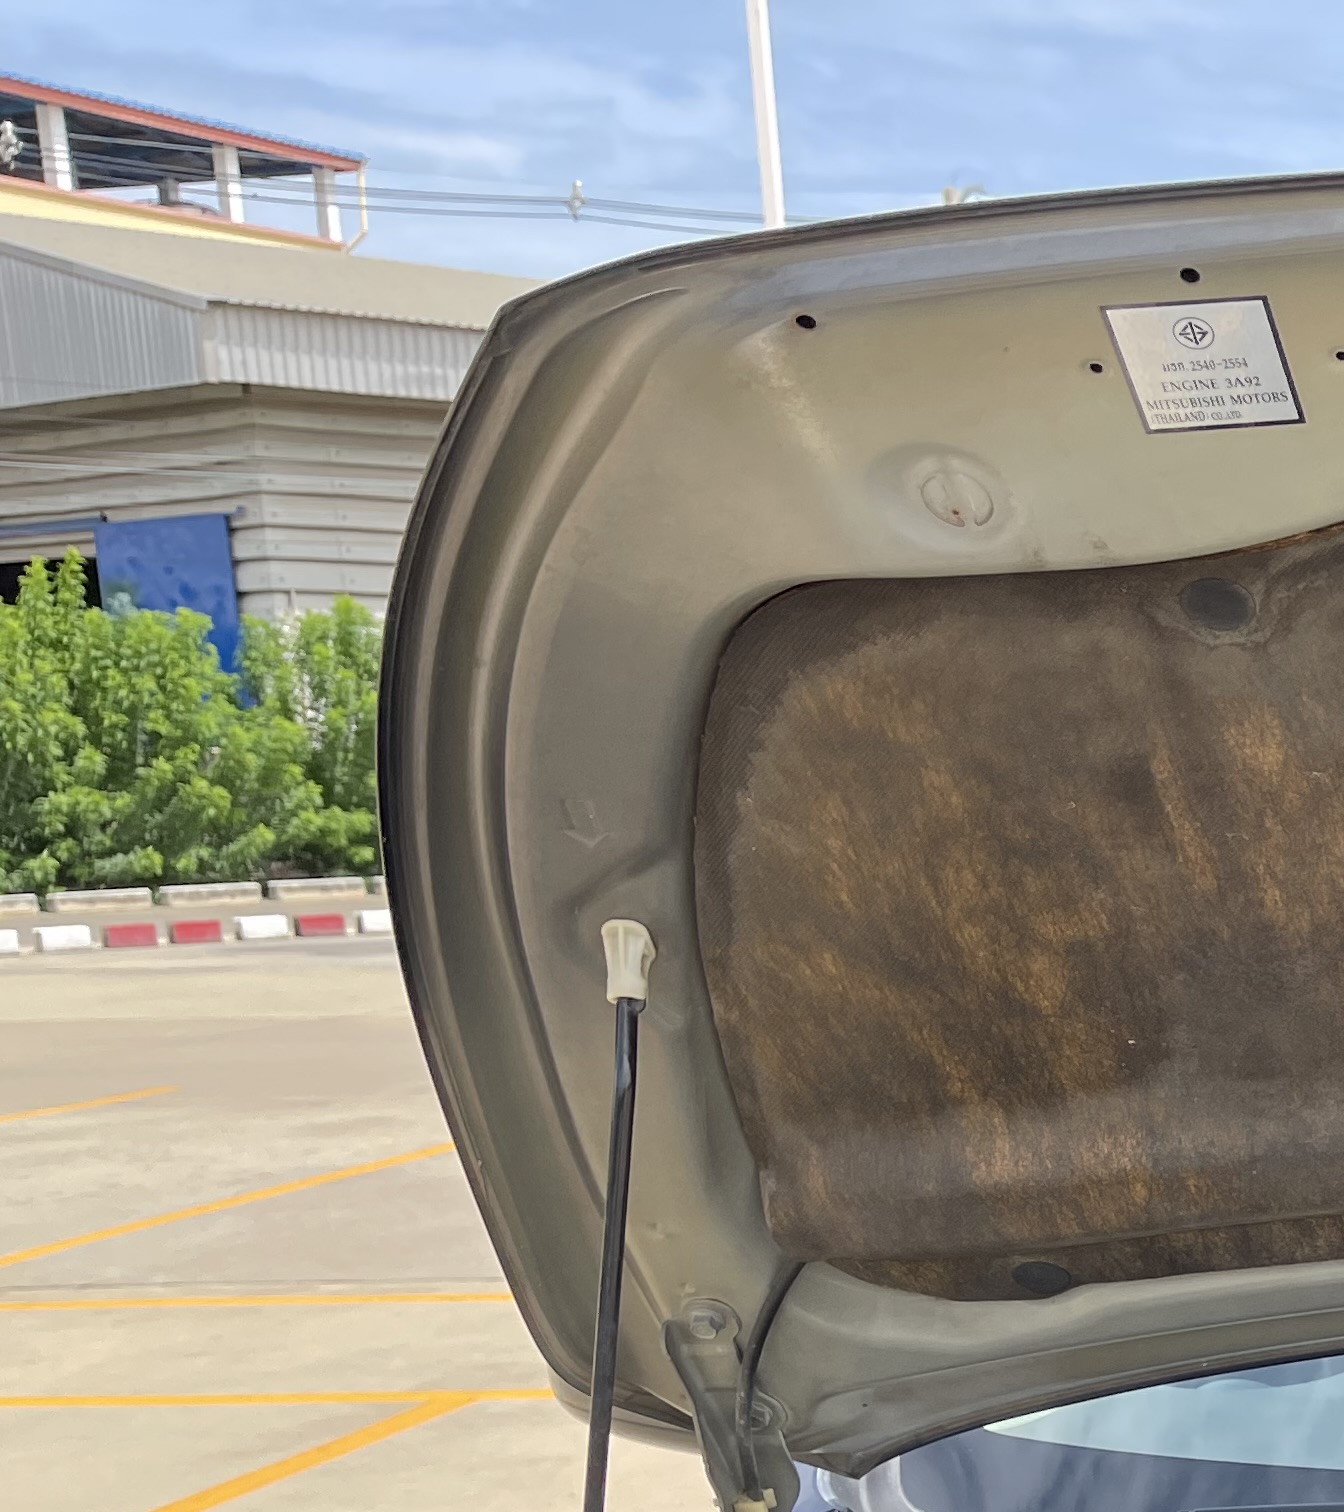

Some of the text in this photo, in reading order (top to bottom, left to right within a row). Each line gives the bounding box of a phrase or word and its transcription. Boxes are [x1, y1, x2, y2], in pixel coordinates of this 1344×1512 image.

[1161, 376, 1262, 393] ENGINE 3A92
[1146, 390, 1289, 411] MITSUBISHI MOTORS
